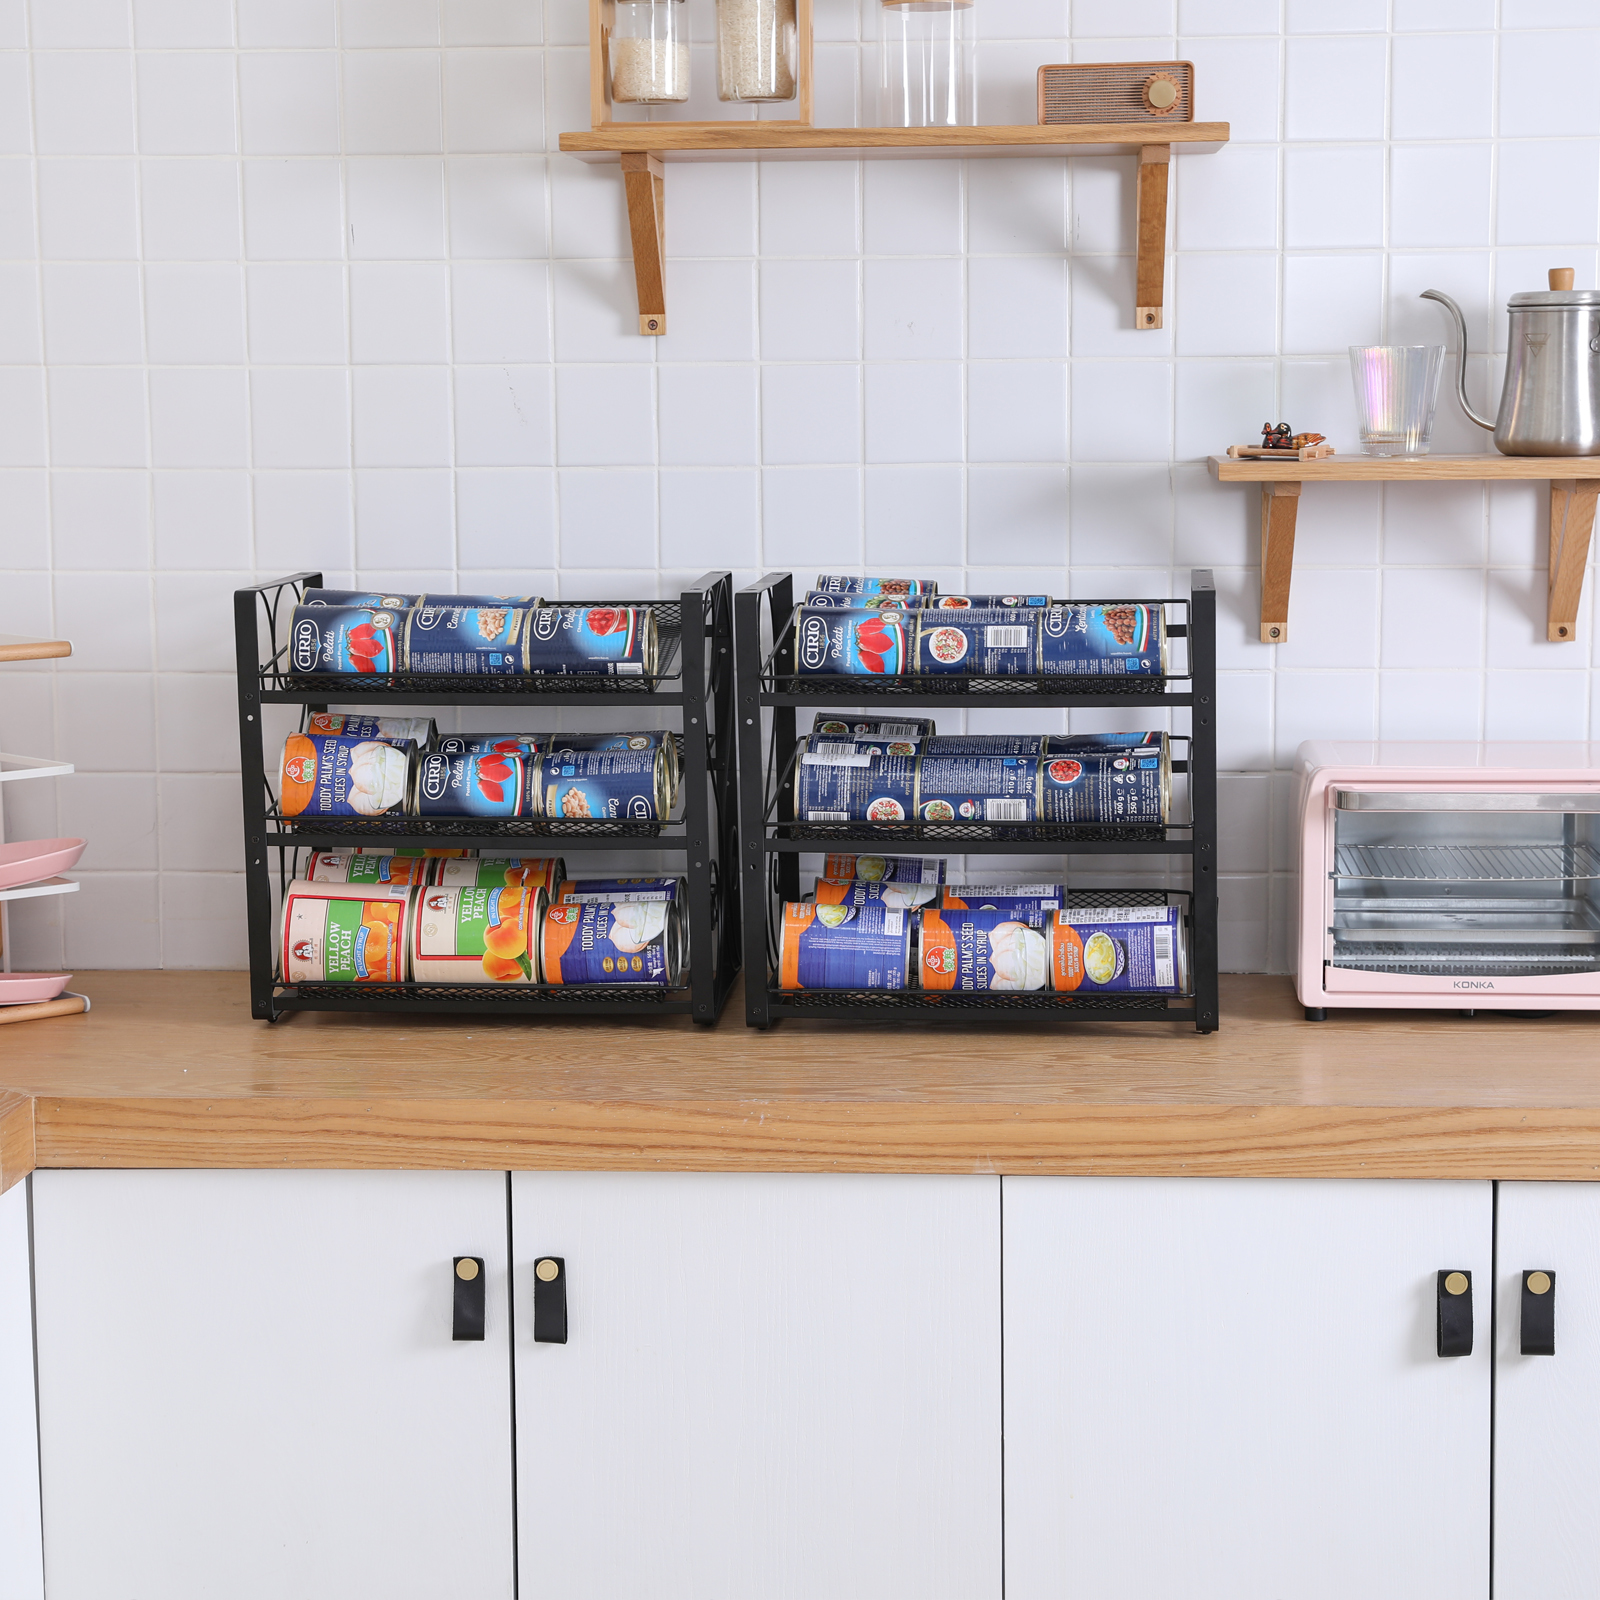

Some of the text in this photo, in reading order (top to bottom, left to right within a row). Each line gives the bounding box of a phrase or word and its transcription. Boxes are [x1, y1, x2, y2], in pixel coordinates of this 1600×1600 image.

[299, 624, 312, 666] CIRIO
[322, 630, 335, 662] Pelati
[806, 620, 820, 663] CIRIO
[831, 626, 843, 658] Pelati
[336, 745, 349, 766] SYRUP
[320, 740, 337, 811] TODDY PALM'S SEED
[428, 756, 442, 793] CIRIO
[452, 760, 465, 788] Pelati
[334, 778, 345, 802] SLICES
[473, 888, 487, 919] PEACH
[582, 925, 594, 951] TODDY
[596, 916, 608, 939] SLICES
[962, 922, 974, 941] SEED
[976, 930, 987, 954] SYRUP
[329, 921, 340, 973] YELLOW
[340, 930, 352, 971] PEACH
[961, 943, 974, 973] PALM'S
[976, 966, 987, 989] SLICES
[1453, 980, 1494, 989] KONKA
